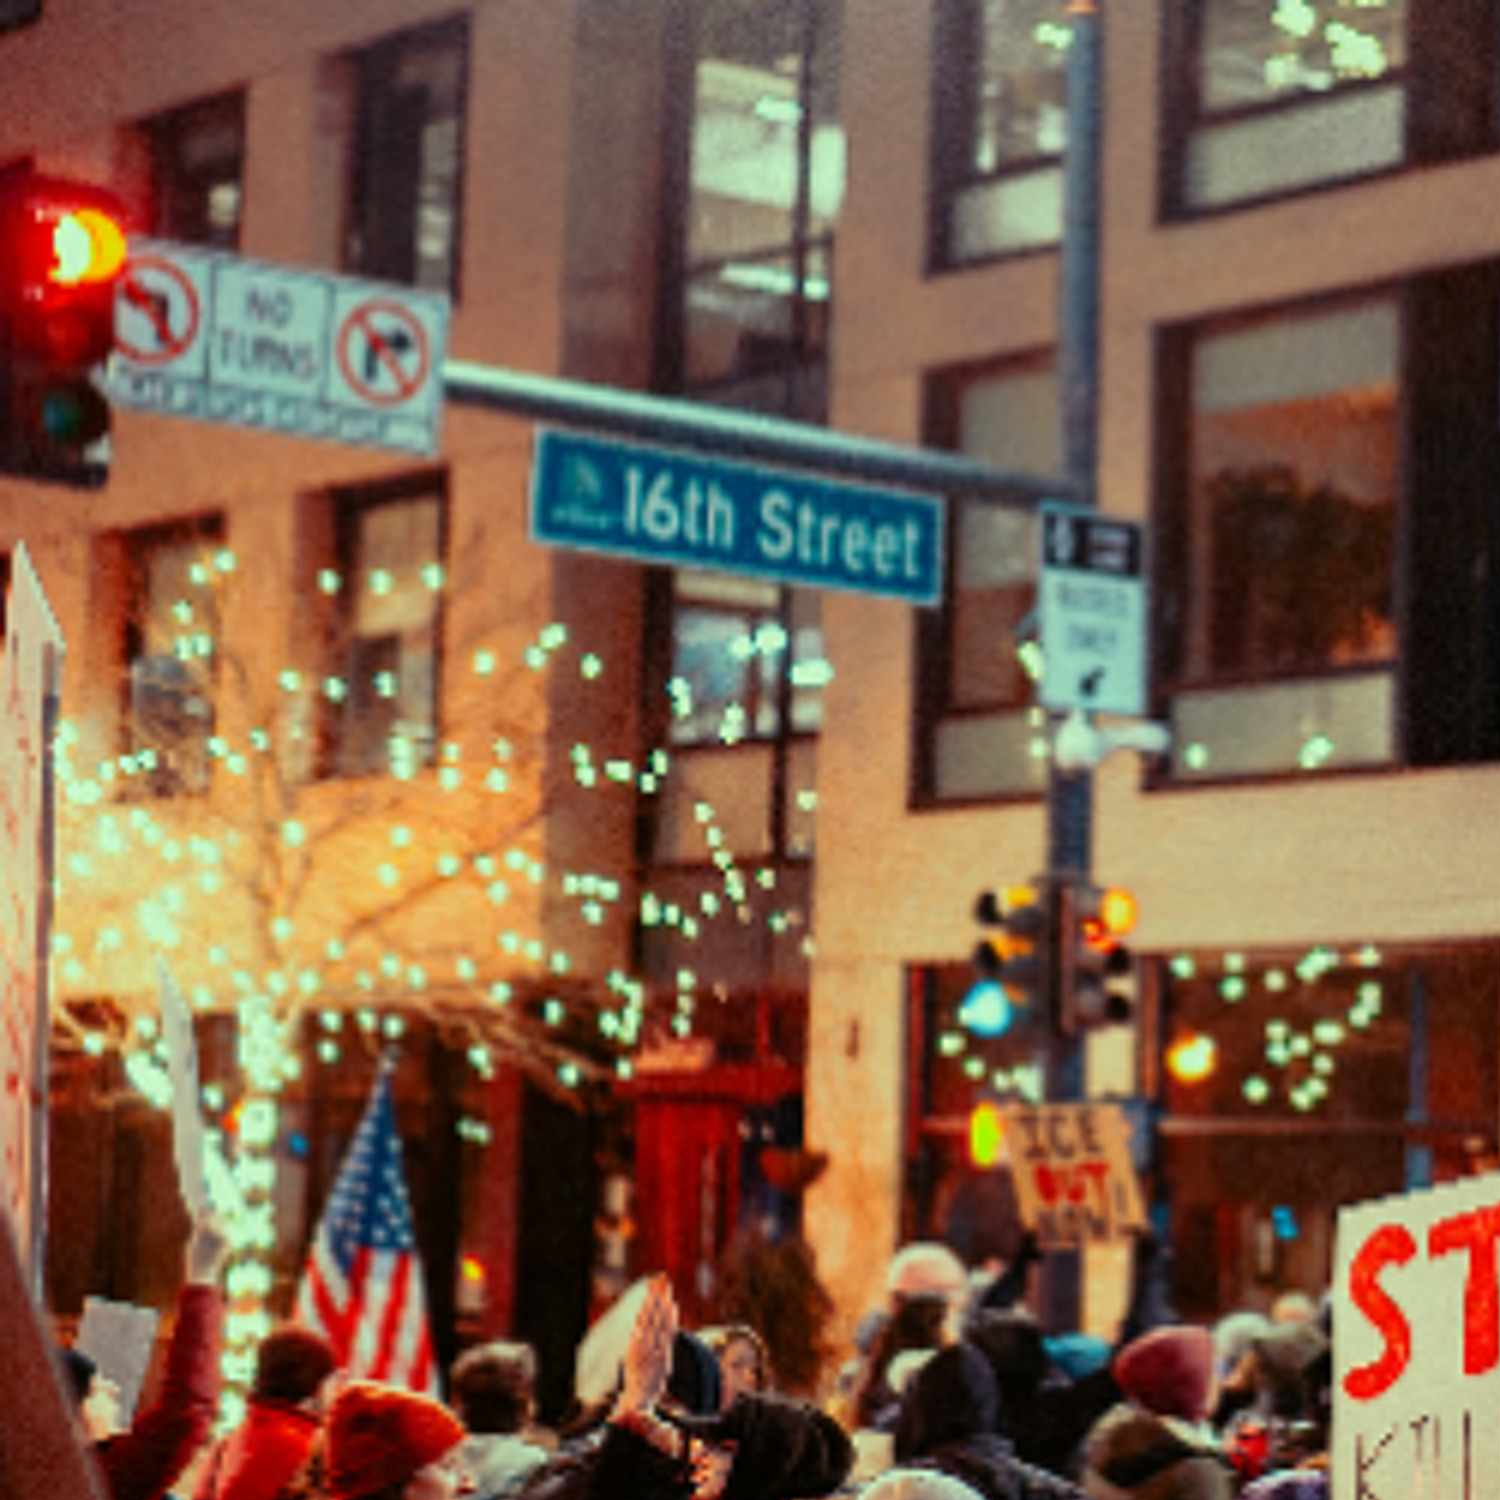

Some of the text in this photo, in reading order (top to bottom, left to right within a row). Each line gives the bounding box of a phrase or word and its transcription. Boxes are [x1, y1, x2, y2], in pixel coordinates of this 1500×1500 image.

[246, 284, 292, 329] NO
[221, 327, 319, 383] TURNS
[623, 464, 920, 578] 16th Street
[1017, 1110, 1103, 1160] ICE
